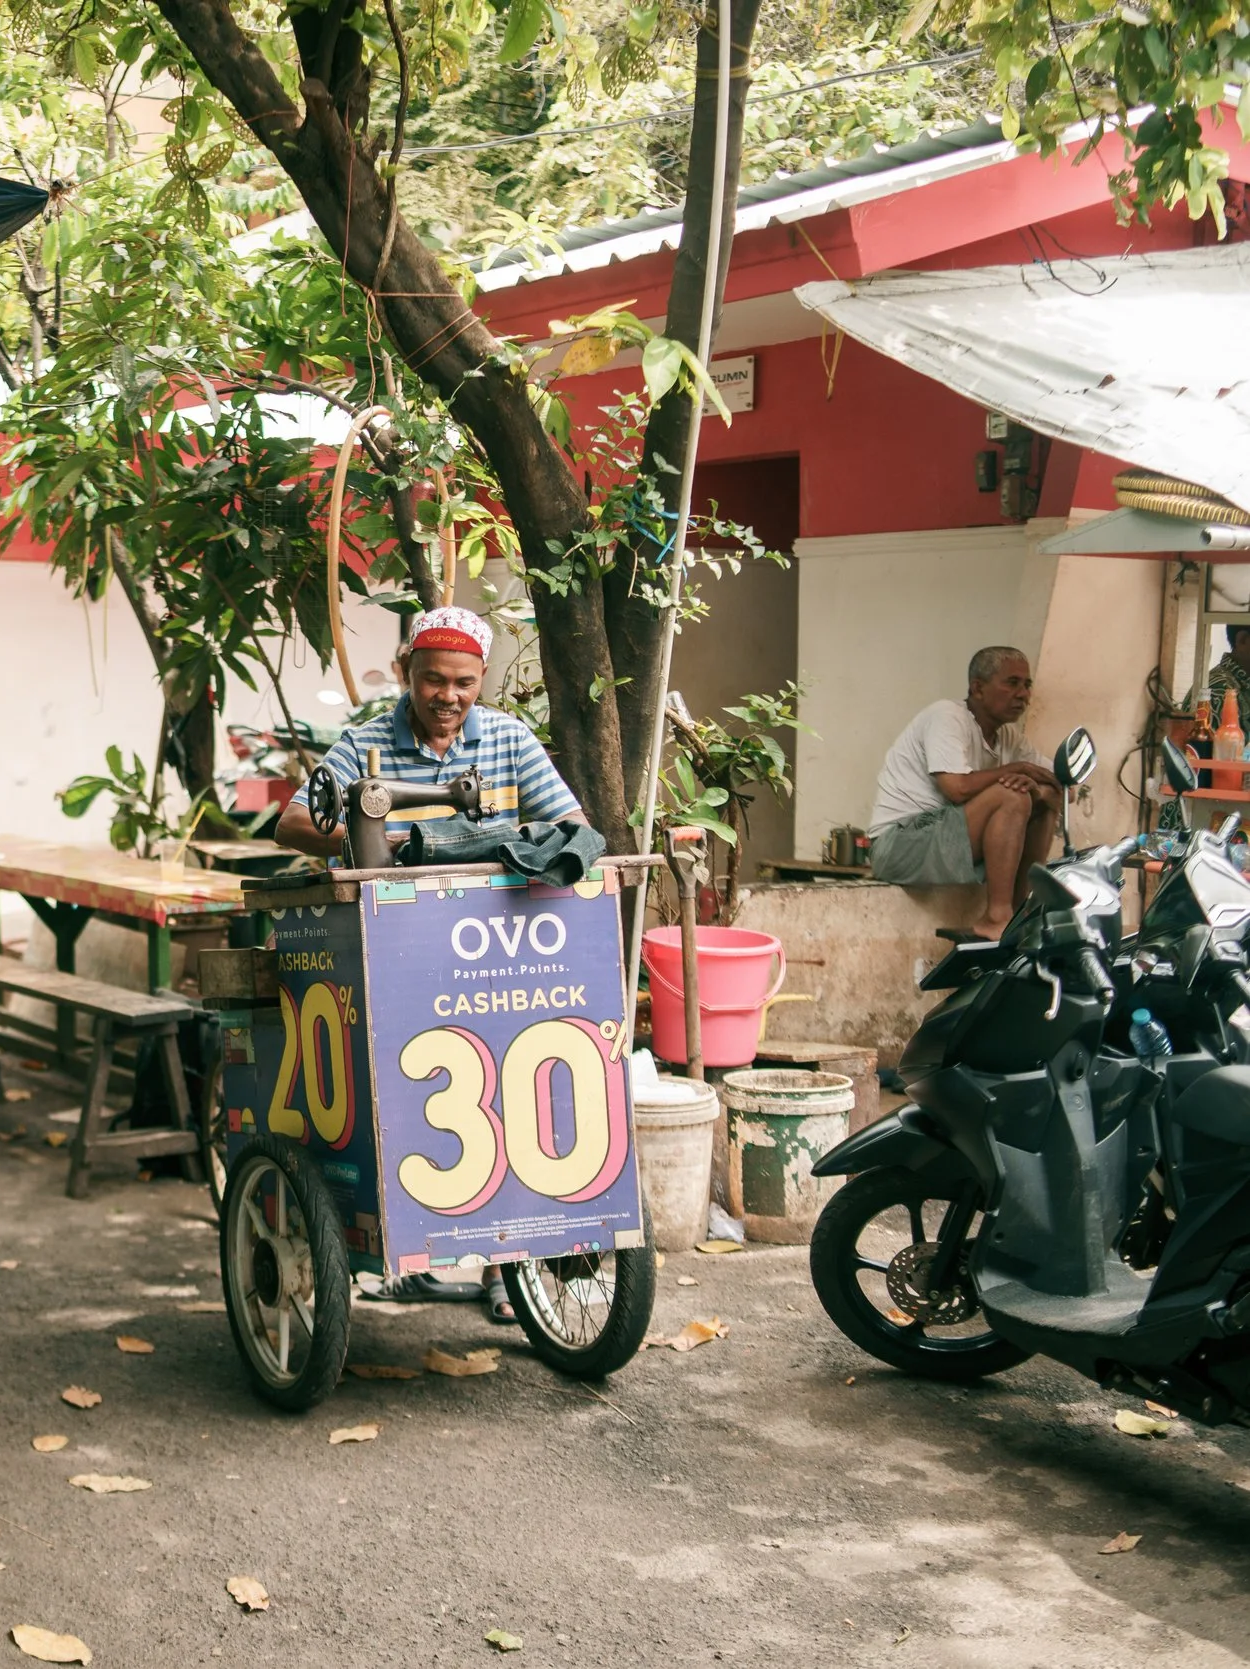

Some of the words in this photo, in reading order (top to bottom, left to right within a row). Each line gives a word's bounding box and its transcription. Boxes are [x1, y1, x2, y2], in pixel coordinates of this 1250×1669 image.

[275, 927, 330, 940] ayment.Points.
[451, 912, 567, 960] OVO
[278, 952, 335, 972] ASHBACK
[454, 963, 570, 979] Payment.Points.
[434, 984, 587, 1017] CASHBACK
